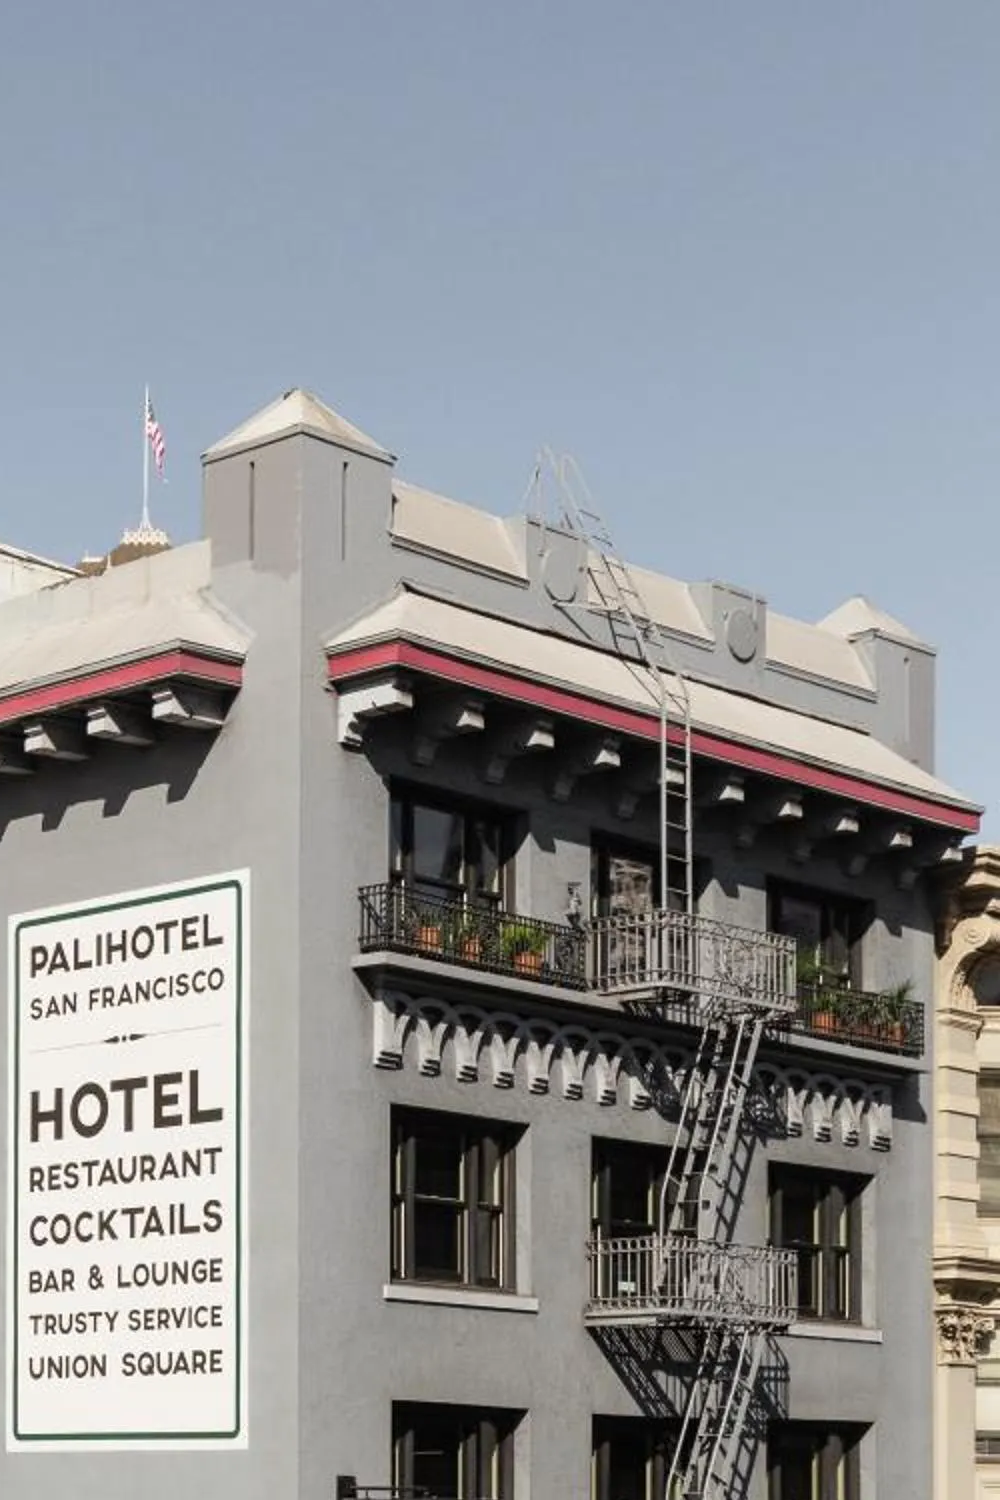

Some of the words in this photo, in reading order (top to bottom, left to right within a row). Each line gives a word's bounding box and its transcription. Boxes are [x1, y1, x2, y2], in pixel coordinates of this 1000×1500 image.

[30, 913, 224, 978] PALIHOTEL
[30, 992, 77, 1020] SAN
[89, 967, 225, 1011] FRANCISCO
[30, 1069, 223, 1143] HOTEL
[29, 1147, 223, 1193] RESTAURANT
[29, 1199, 223, 1247] COCKTAILS
[29, 1269, 75, 1294] BAR
[88, 1264, 104, 1291] &
[117, 1258, 223, 1288] LOUNGE
[29, 1309, 119, 1335] TRUSTY
[128, 1305, 223, 1331] SERVICE
[29, 1354, 107, 1380] UNION
[122, 1349, 223, 1377] SQUARE
